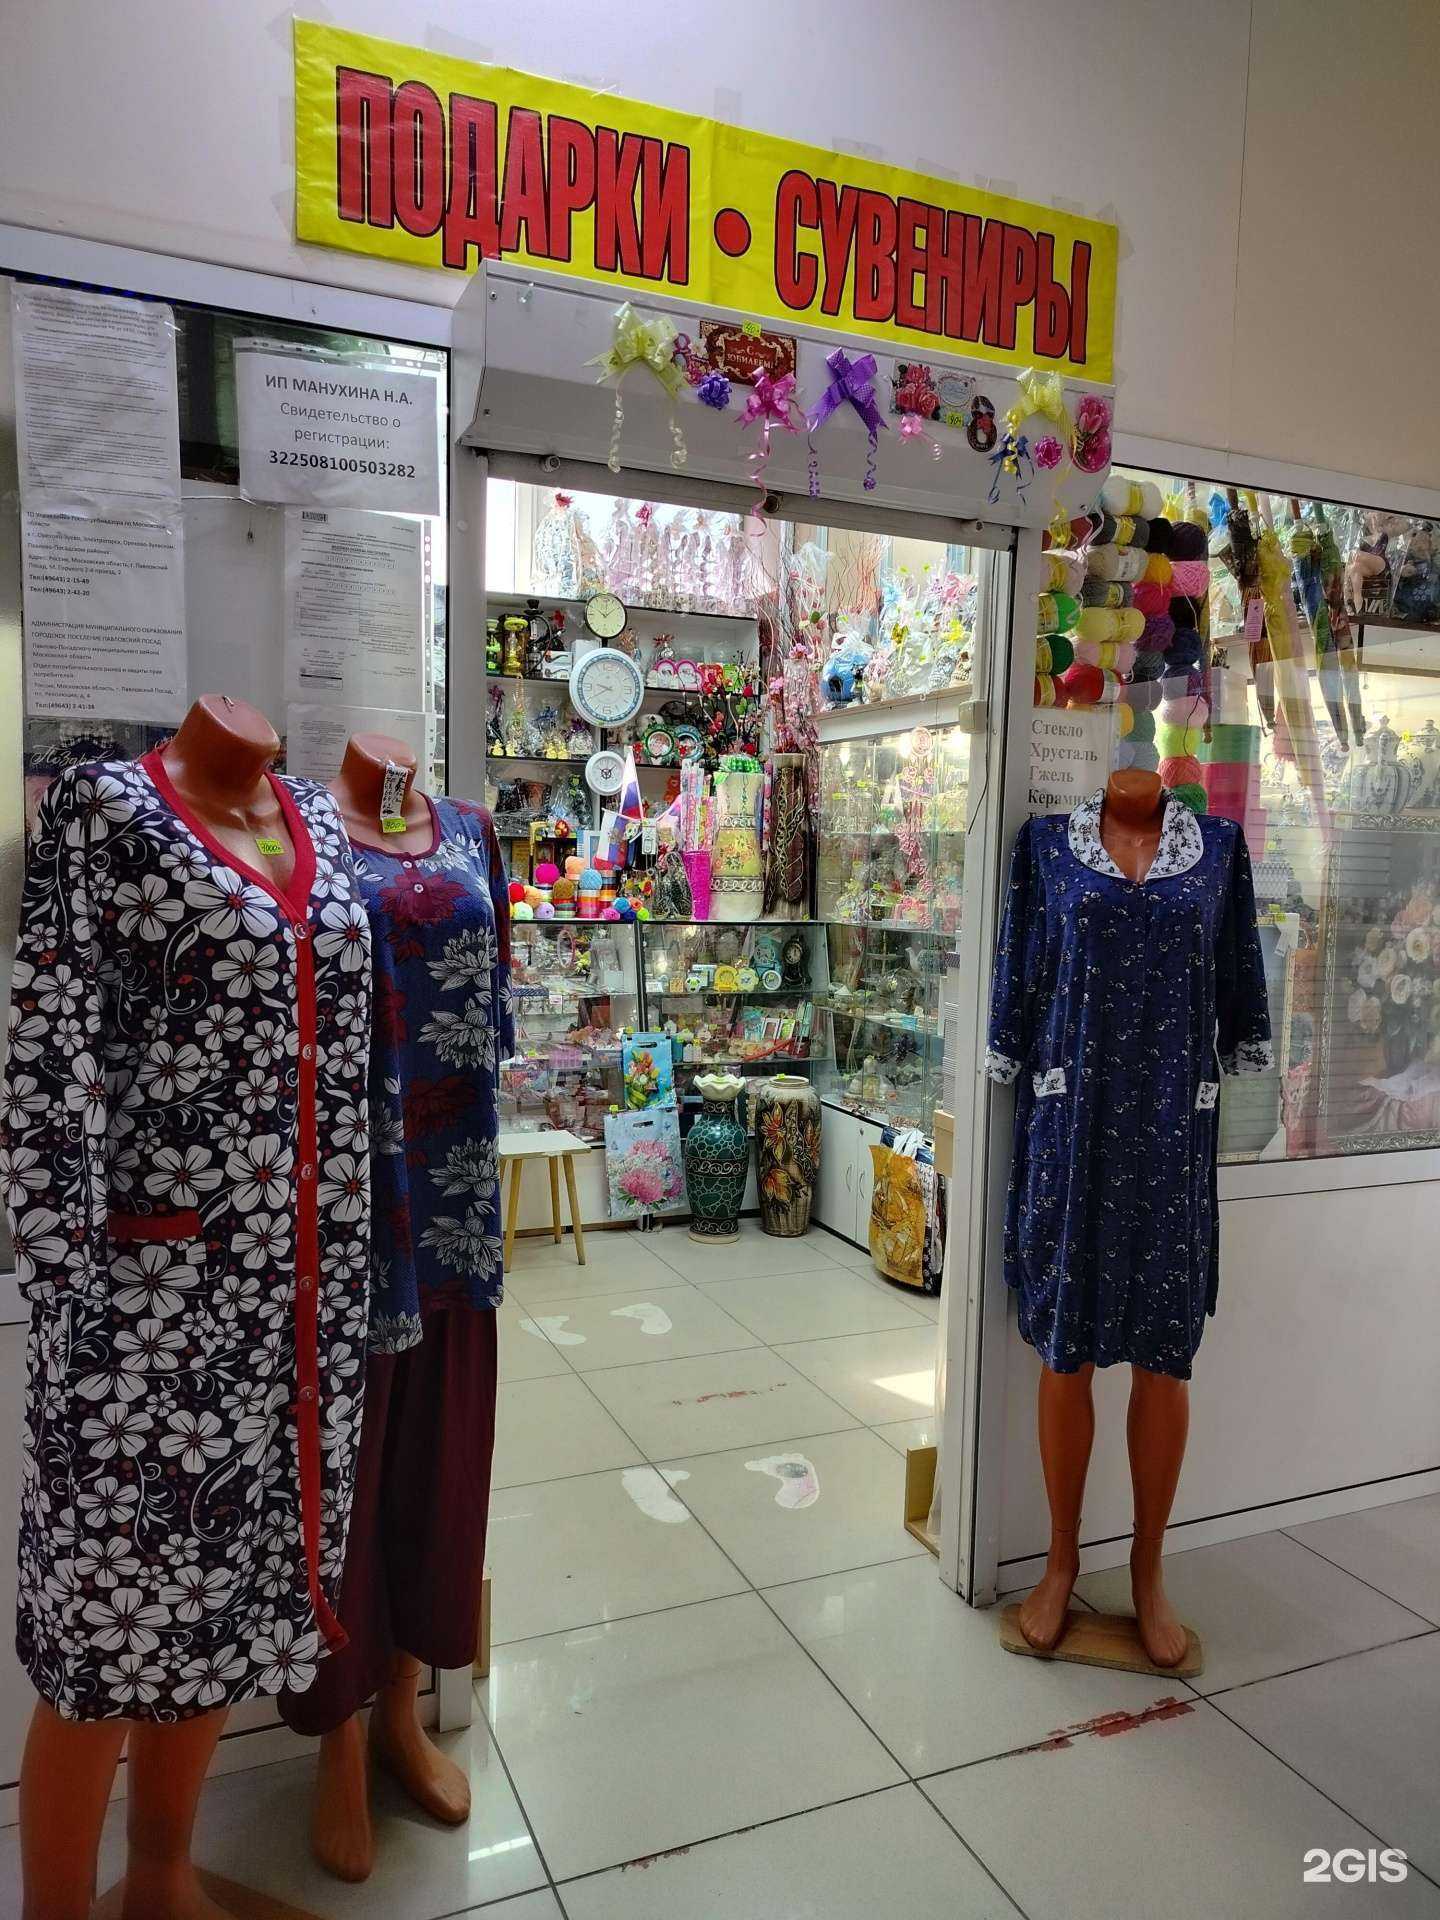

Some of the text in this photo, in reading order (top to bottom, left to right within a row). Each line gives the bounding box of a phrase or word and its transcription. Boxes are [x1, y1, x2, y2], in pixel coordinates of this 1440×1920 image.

[336, 65, 690, 286] ПОДАРКИ
[774, 169, 1091, 365] СУВЕНИРЫ
[265, 374, 413, 405] ИП МАНУХИНА Н.А.
[280, 402, 401, 428] Свидетельство о
[294, 428, 390, 449] регистрации:
[269, 450, 416, 478] 322508100503282
[1032, 719, 1083, 738] Стекло
[1030, 742, 1098, 762] Хрусталь
[1029, 765, 1074, 783] Гжель
[1028, 788, 1088, 808] Керами
